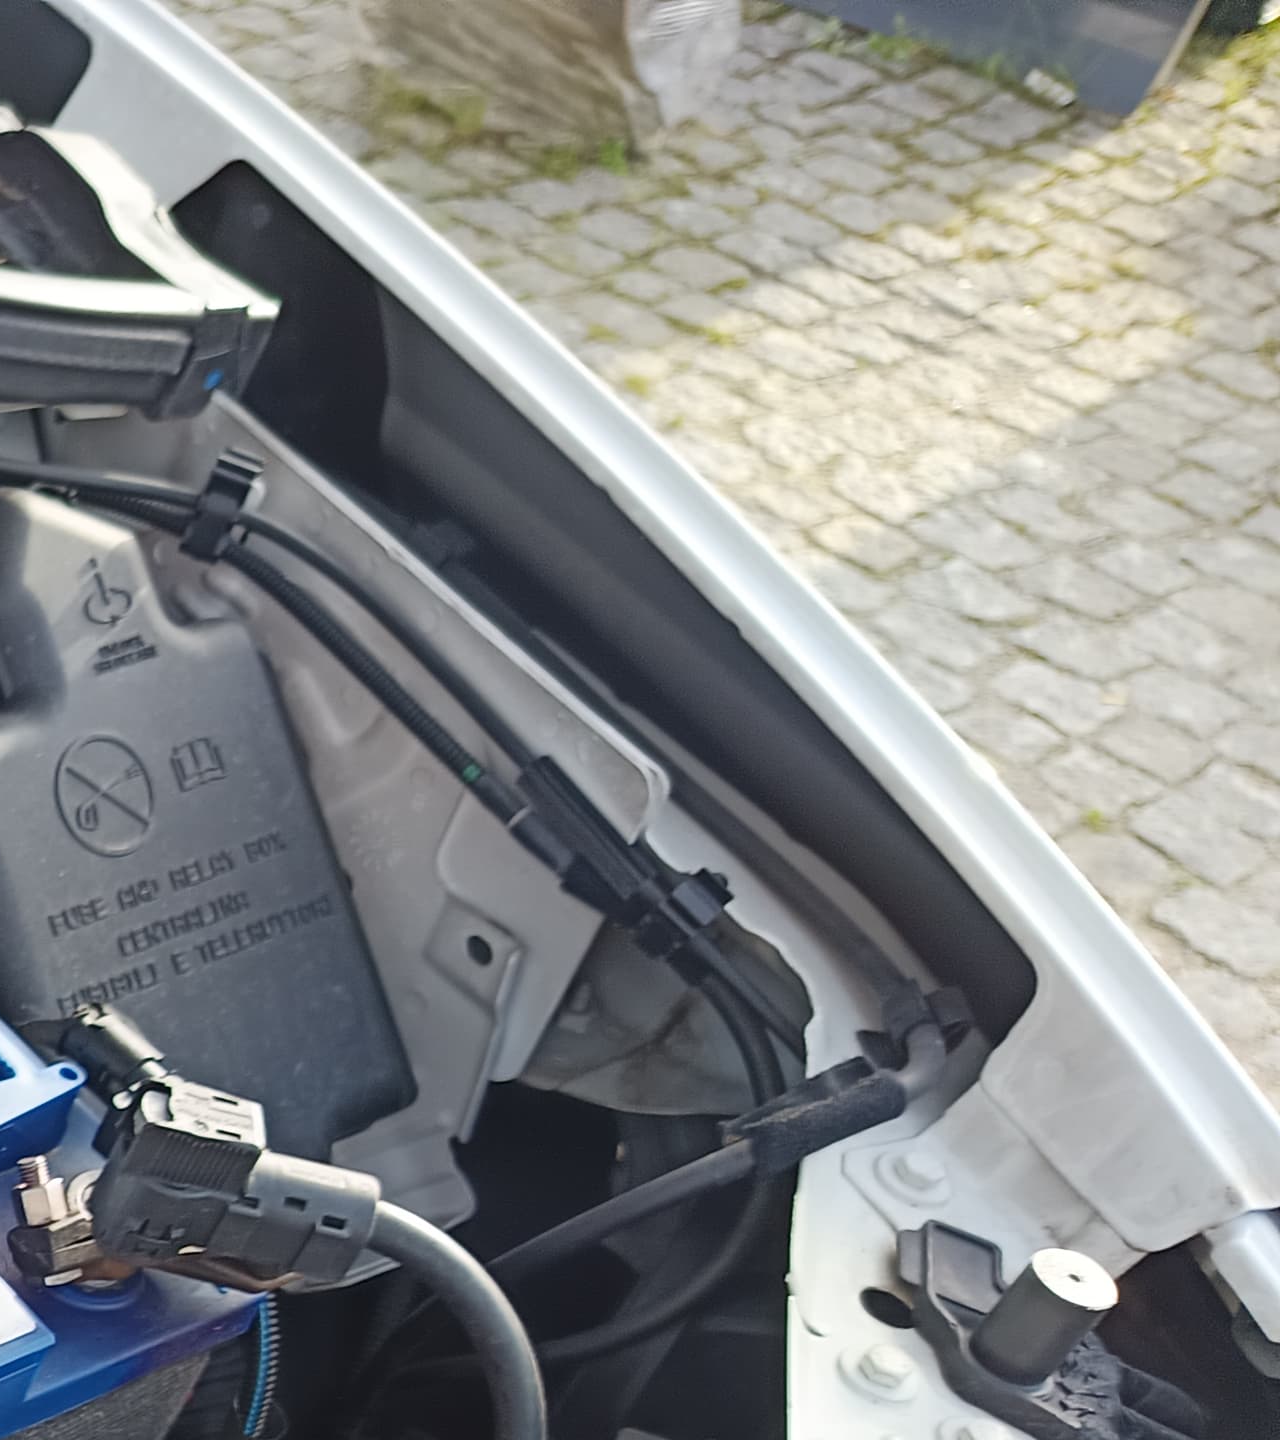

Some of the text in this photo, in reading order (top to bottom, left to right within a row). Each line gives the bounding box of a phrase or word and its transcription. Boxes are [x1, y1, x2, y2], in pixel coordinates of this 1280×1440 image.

[47, 897, 110, 938] FUSE
[168, 850, 236, 891] RELAY
[243, 831, 287, 864] BOX
[170, 952, 191, 976] E
